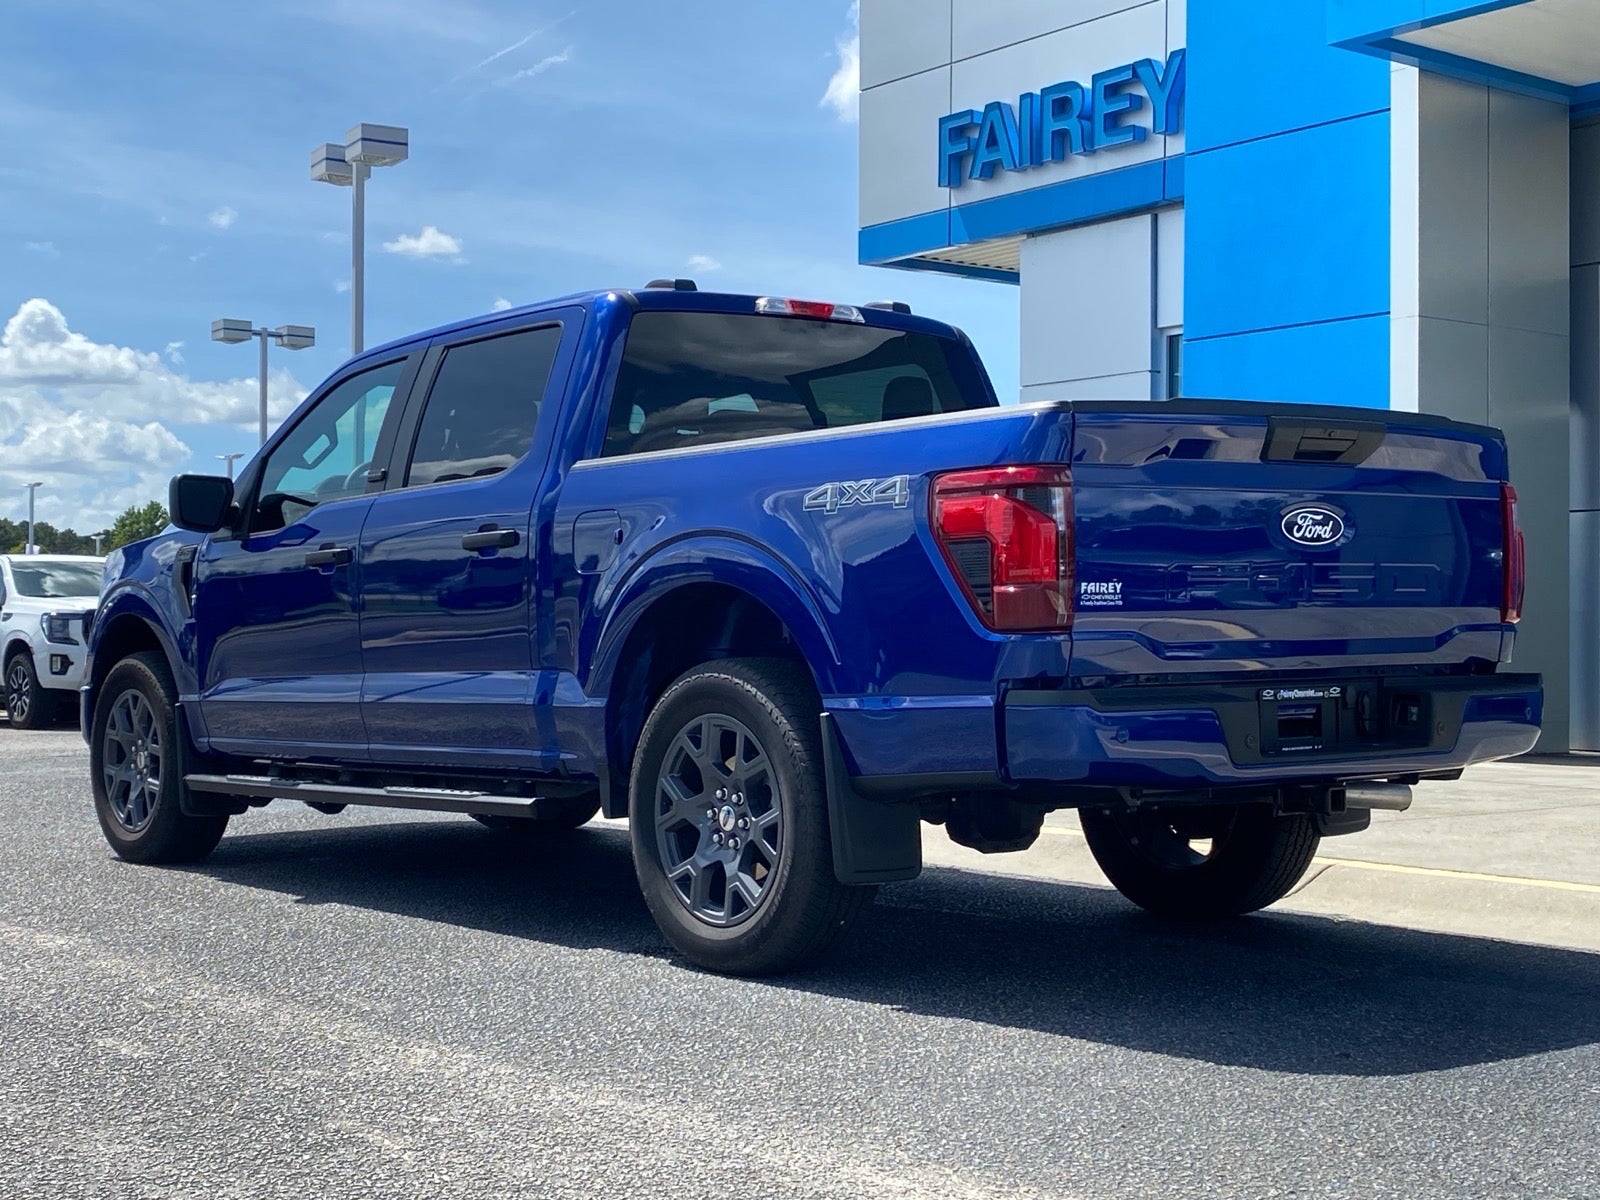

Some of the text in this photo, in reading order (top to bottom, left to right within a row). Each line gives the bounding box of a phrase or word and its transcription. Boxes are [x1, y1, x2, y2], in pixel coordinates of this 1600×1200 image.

[938, 48, 1186, 187] FAIREY
[1293, 513, 1333, 538] Ford
[1081, 582, 1122, 594] FAIREY
